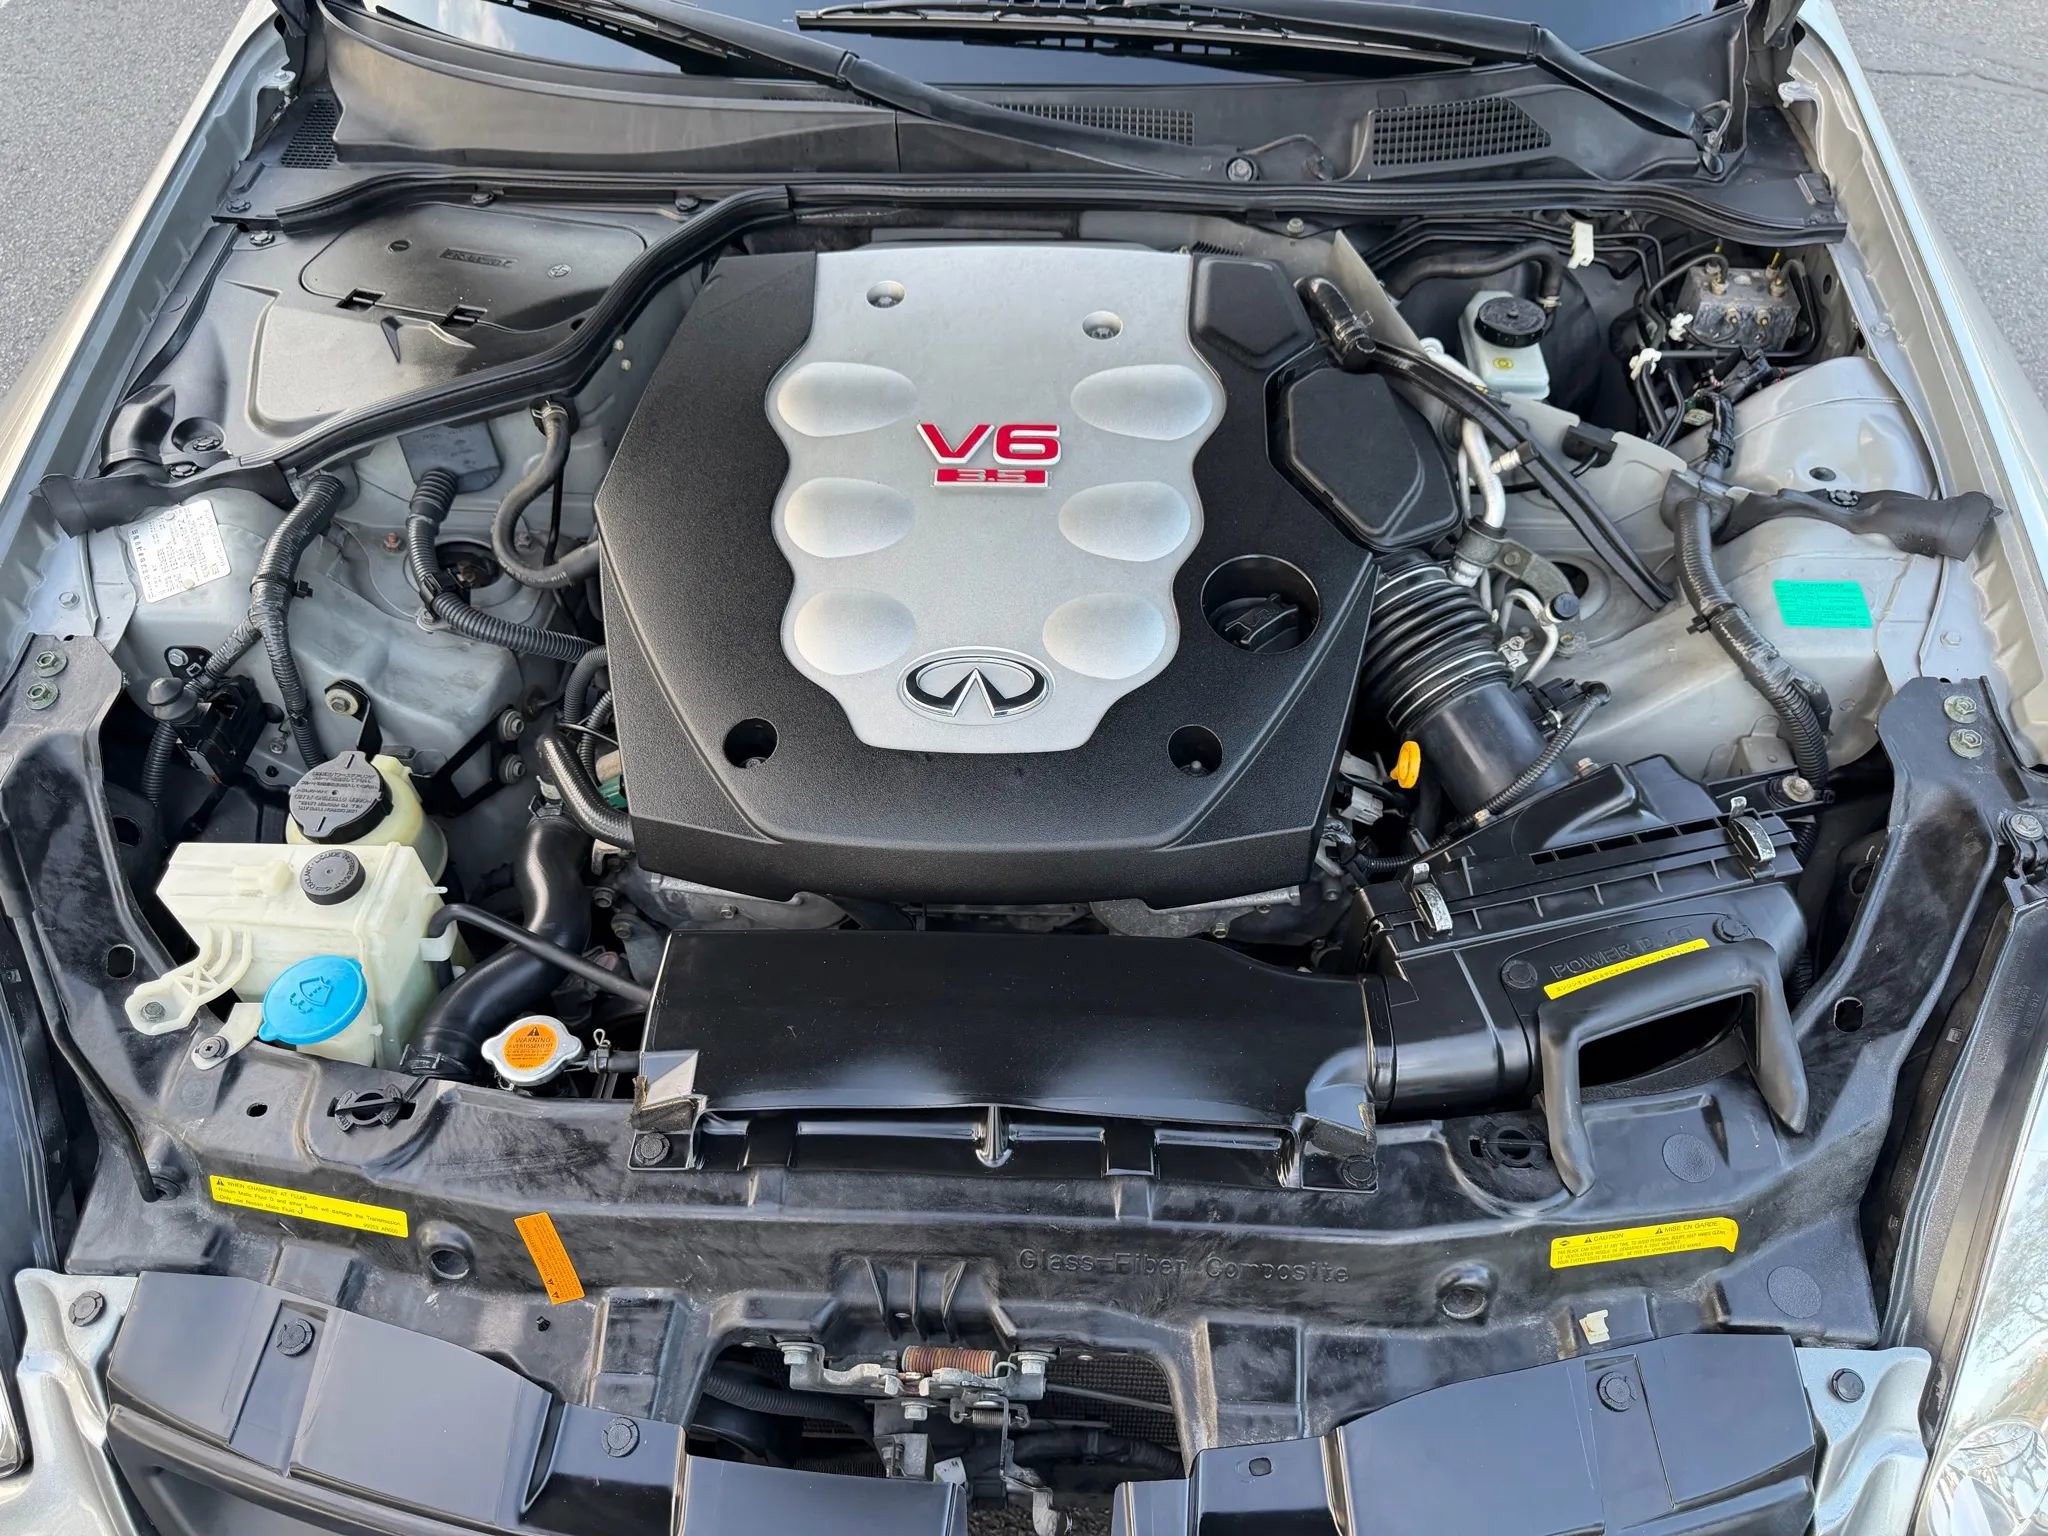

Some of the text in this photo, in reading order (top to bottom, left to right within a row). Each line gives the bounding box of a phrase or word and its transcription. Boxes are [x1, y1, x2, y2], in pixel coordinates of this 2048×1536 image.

[917, 423, 1062, 465] V6
[956, 468, 1027, 482] 3.5
[1665, 1225, 1681, 1233] MISE
[1694, 1221, 1719, 1229] GARDE
[1593, 1233, 1624, 1242] CAUTION
[1018, 1248, 1188, 1275] Glass-Fiber
